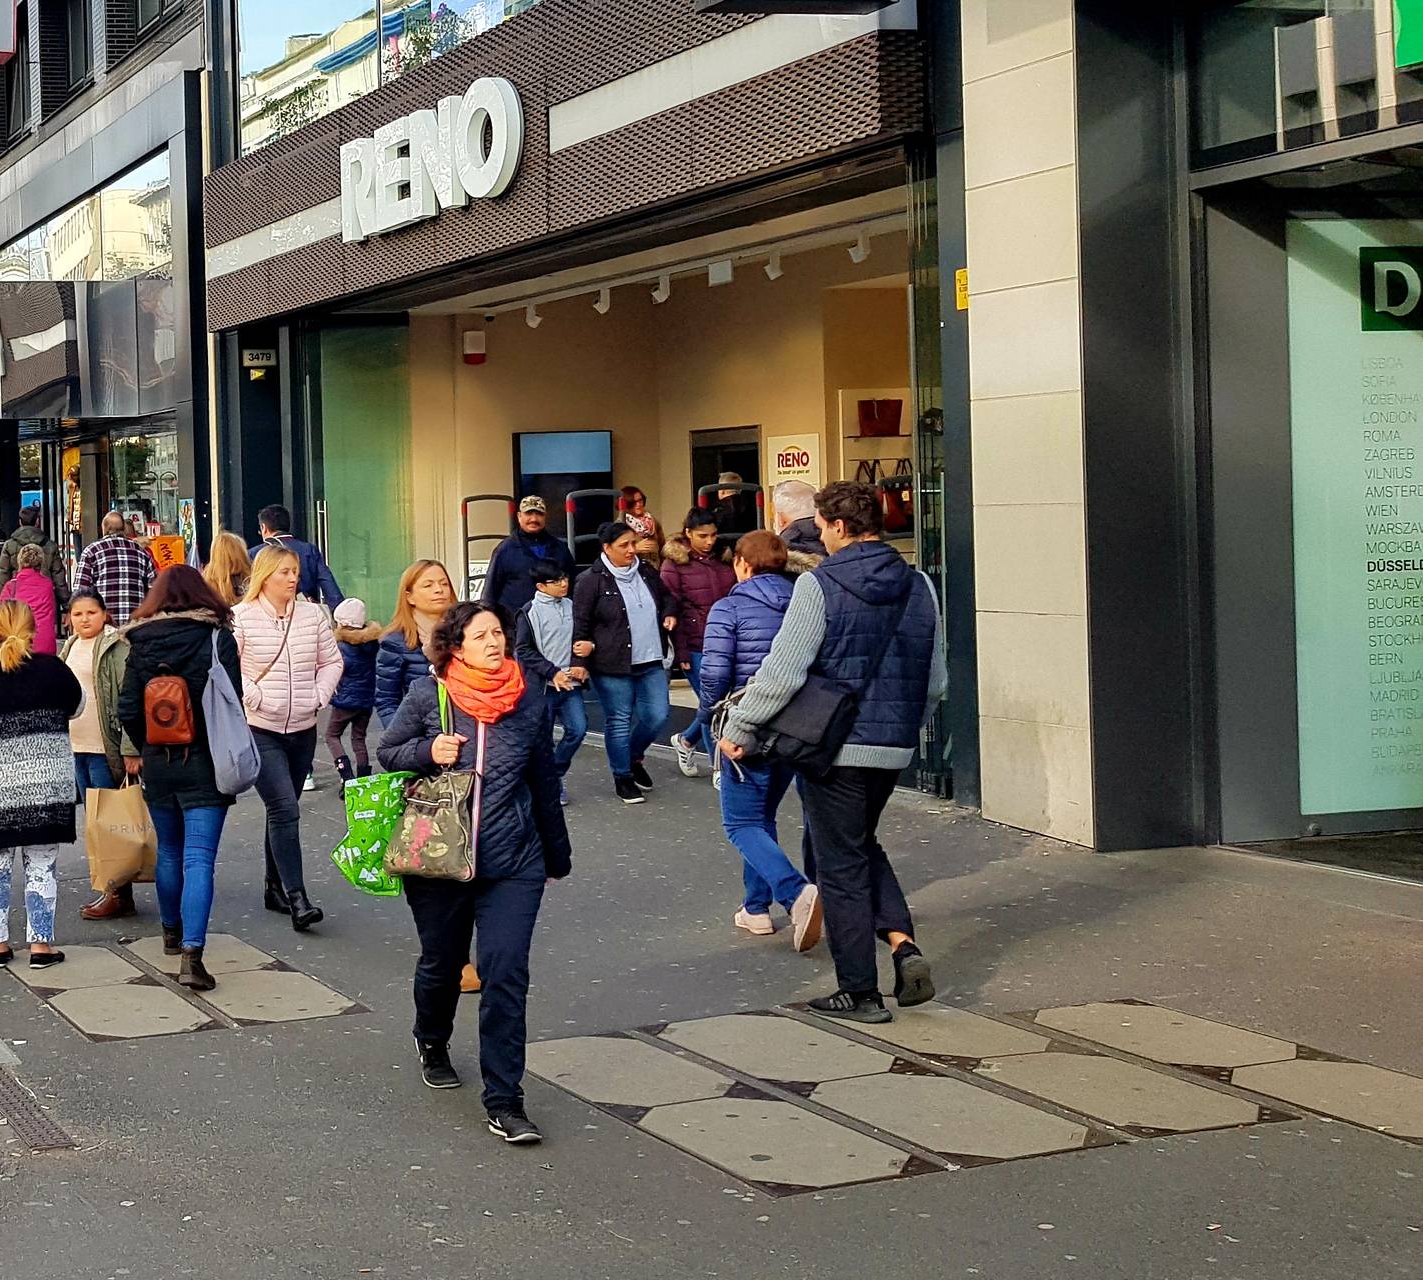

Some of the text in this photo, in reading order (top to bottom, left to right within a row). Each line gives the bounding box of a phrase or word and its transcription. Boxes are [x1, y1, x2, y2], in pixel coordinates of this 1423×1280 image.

[340, 77, 523, 243] RENO
[248, 352, 272, 362] 3479
[1363, 411, 1417, 424] LONDON
[1363, 430, 1401, 442] ROMA
[777, 451, 810, 468] RENO
[1364, 448, 1415, 461] ZAGREB
[1365, 467, 1413, 479] VILNIUS
[1365, 505, 1398, 517] WIEN
[1369, 653, 1403, 665] BERN
[1370, 688, 1419, 702] MADRID
